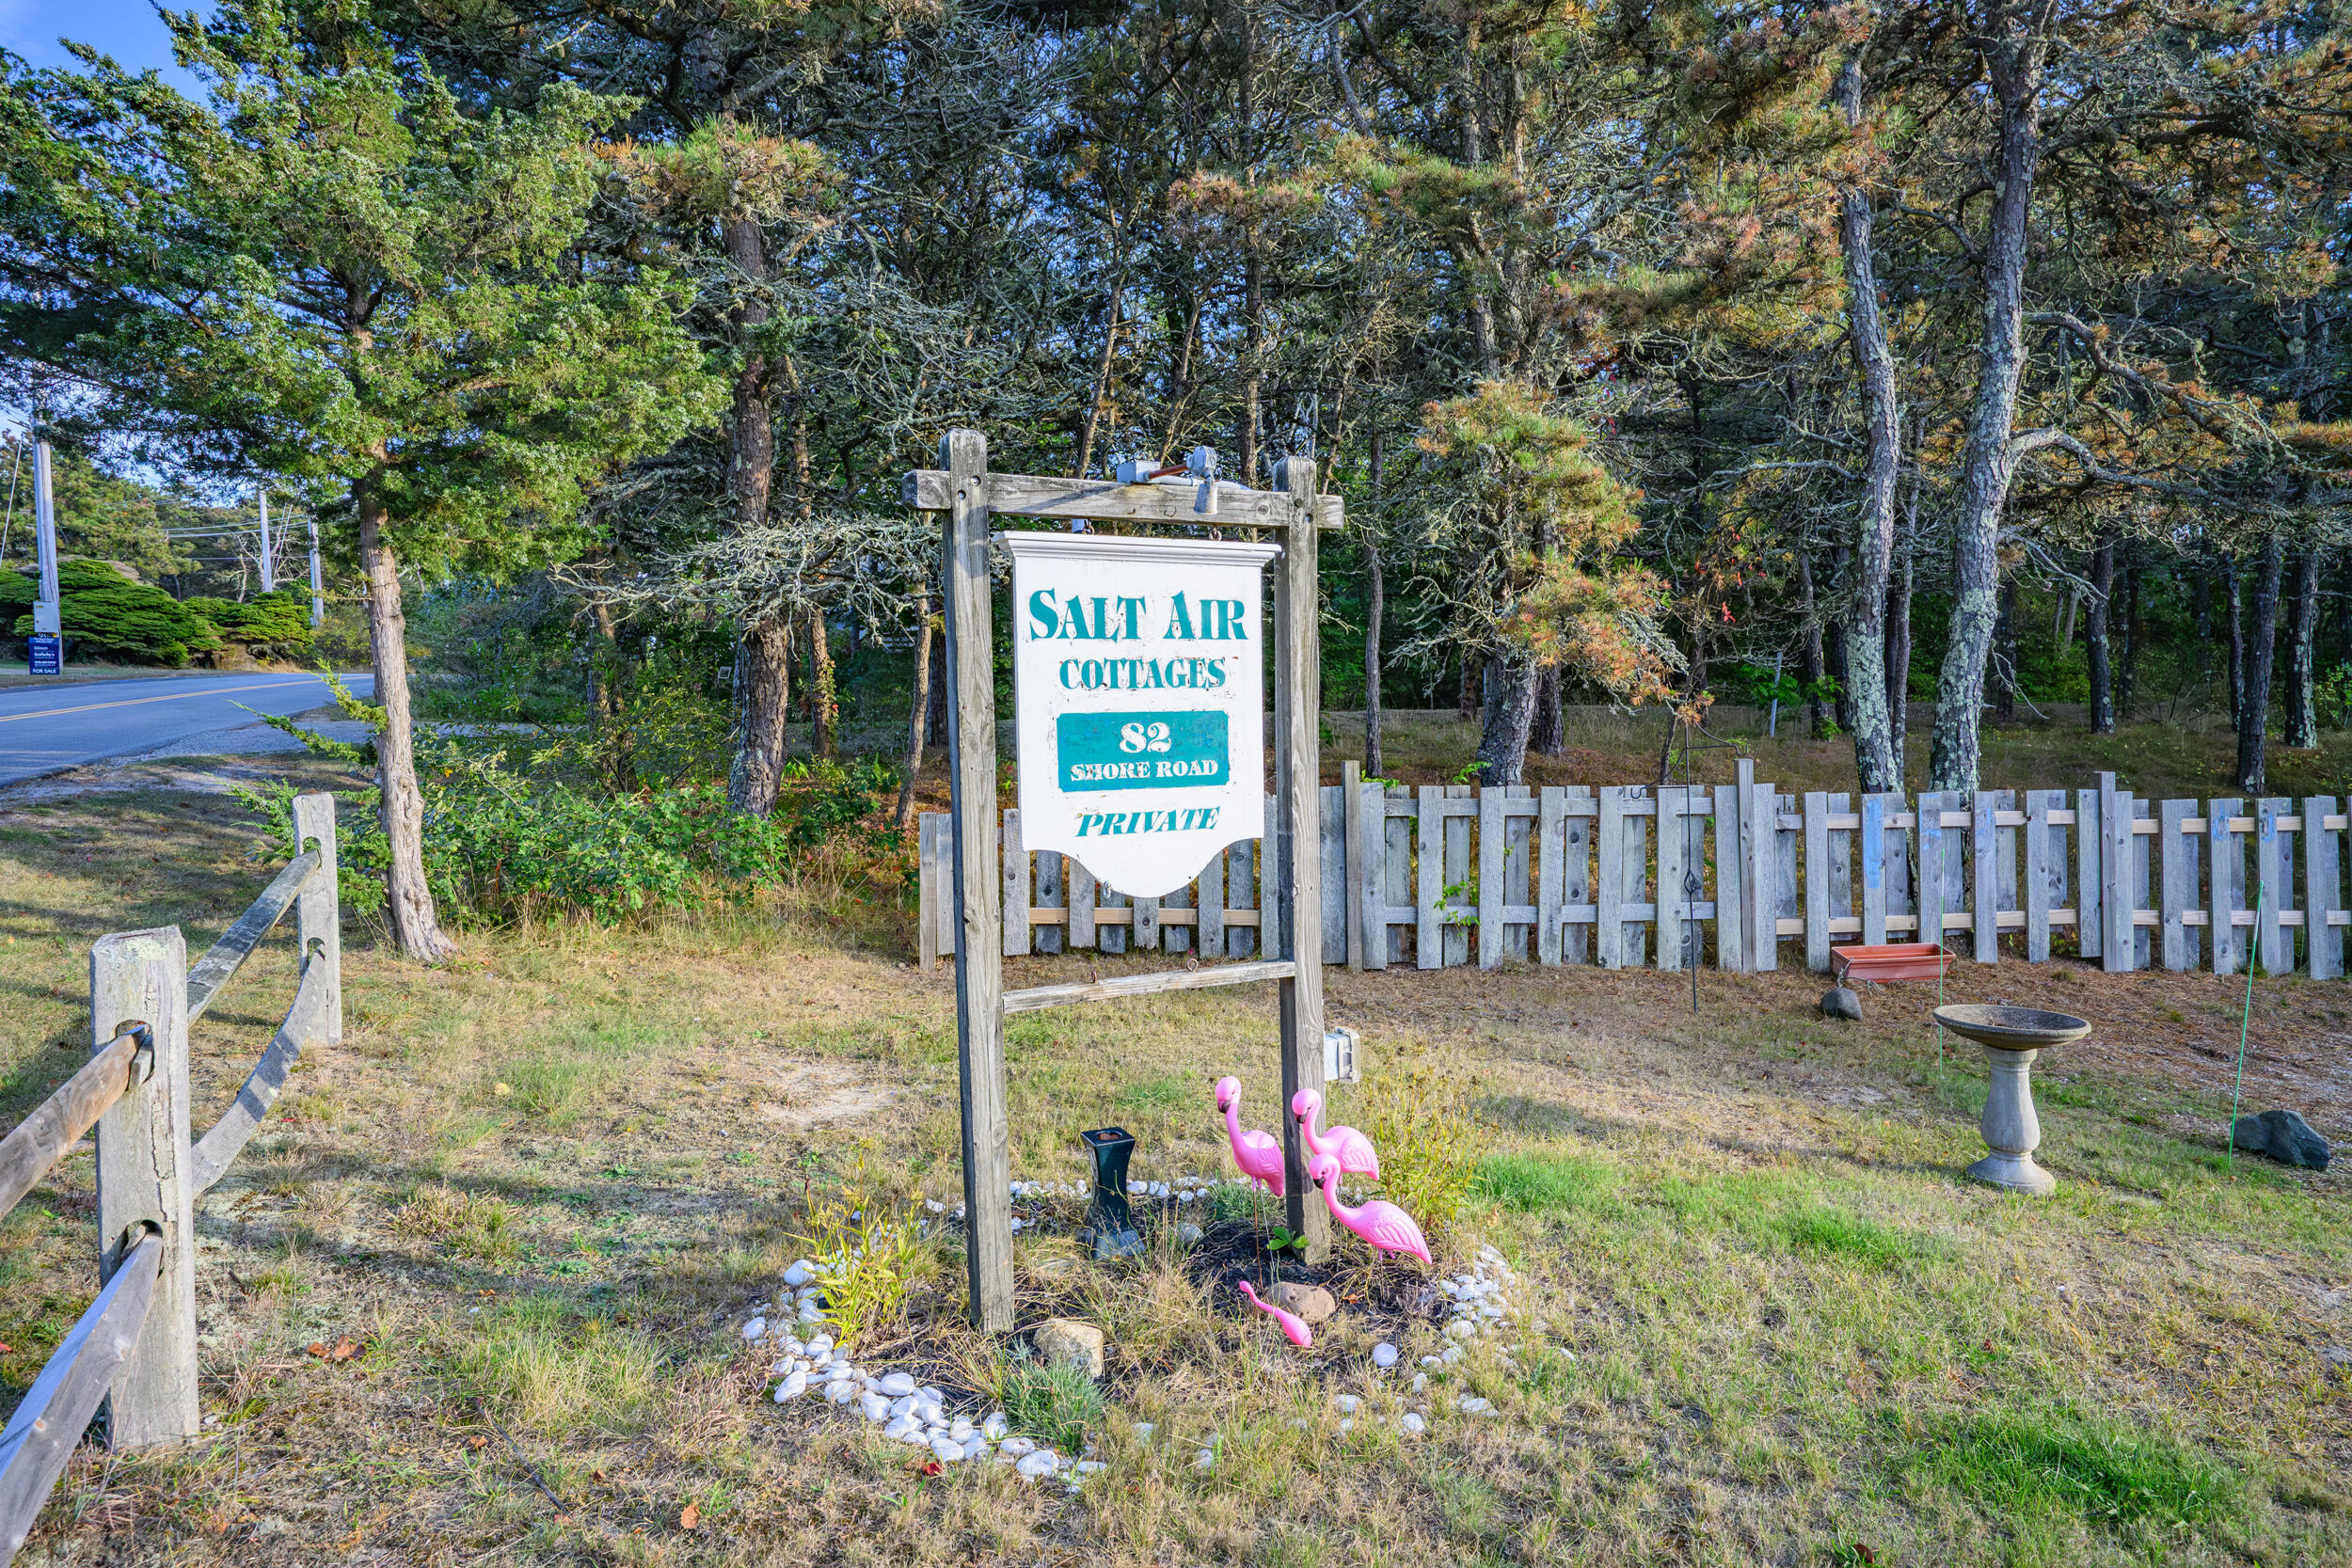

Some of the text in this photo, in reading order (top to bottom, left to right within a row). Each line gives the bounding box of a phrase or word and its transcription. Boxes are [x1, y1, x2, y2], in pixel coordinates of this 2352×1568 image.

[1028, 588, 1248, 643] SALT AIR
[1059, 657, 1226, 690] COTTAGES
[1119, 721, 1172, 753] 82
[1070, 759, 1218, 782] SHORE ROAD
[1075, 806, 1221, 837] PRIVATE
